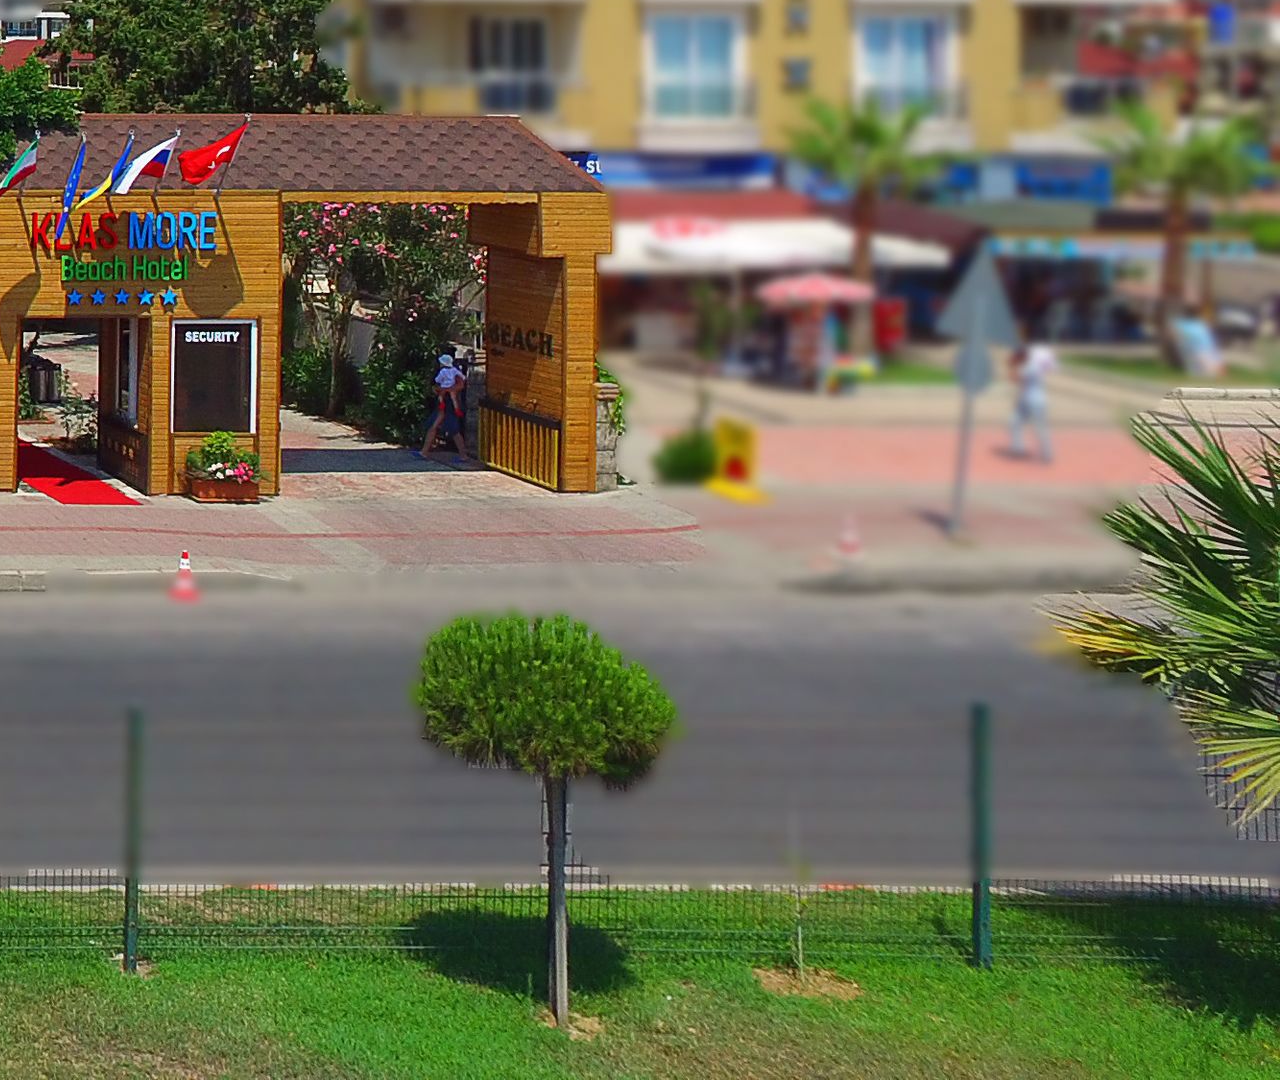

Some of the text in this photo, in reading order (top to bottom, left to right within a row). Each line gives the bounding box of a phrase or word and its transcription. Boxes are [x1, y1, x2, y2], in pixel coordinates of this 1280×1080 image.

[31, 211, 218, 250] KLAS MORE
[61, 255, 189, 281] Beach Hotel
[184, 331, 240, 343] SECURITY
[489, 322, 554, 357] BEACH
